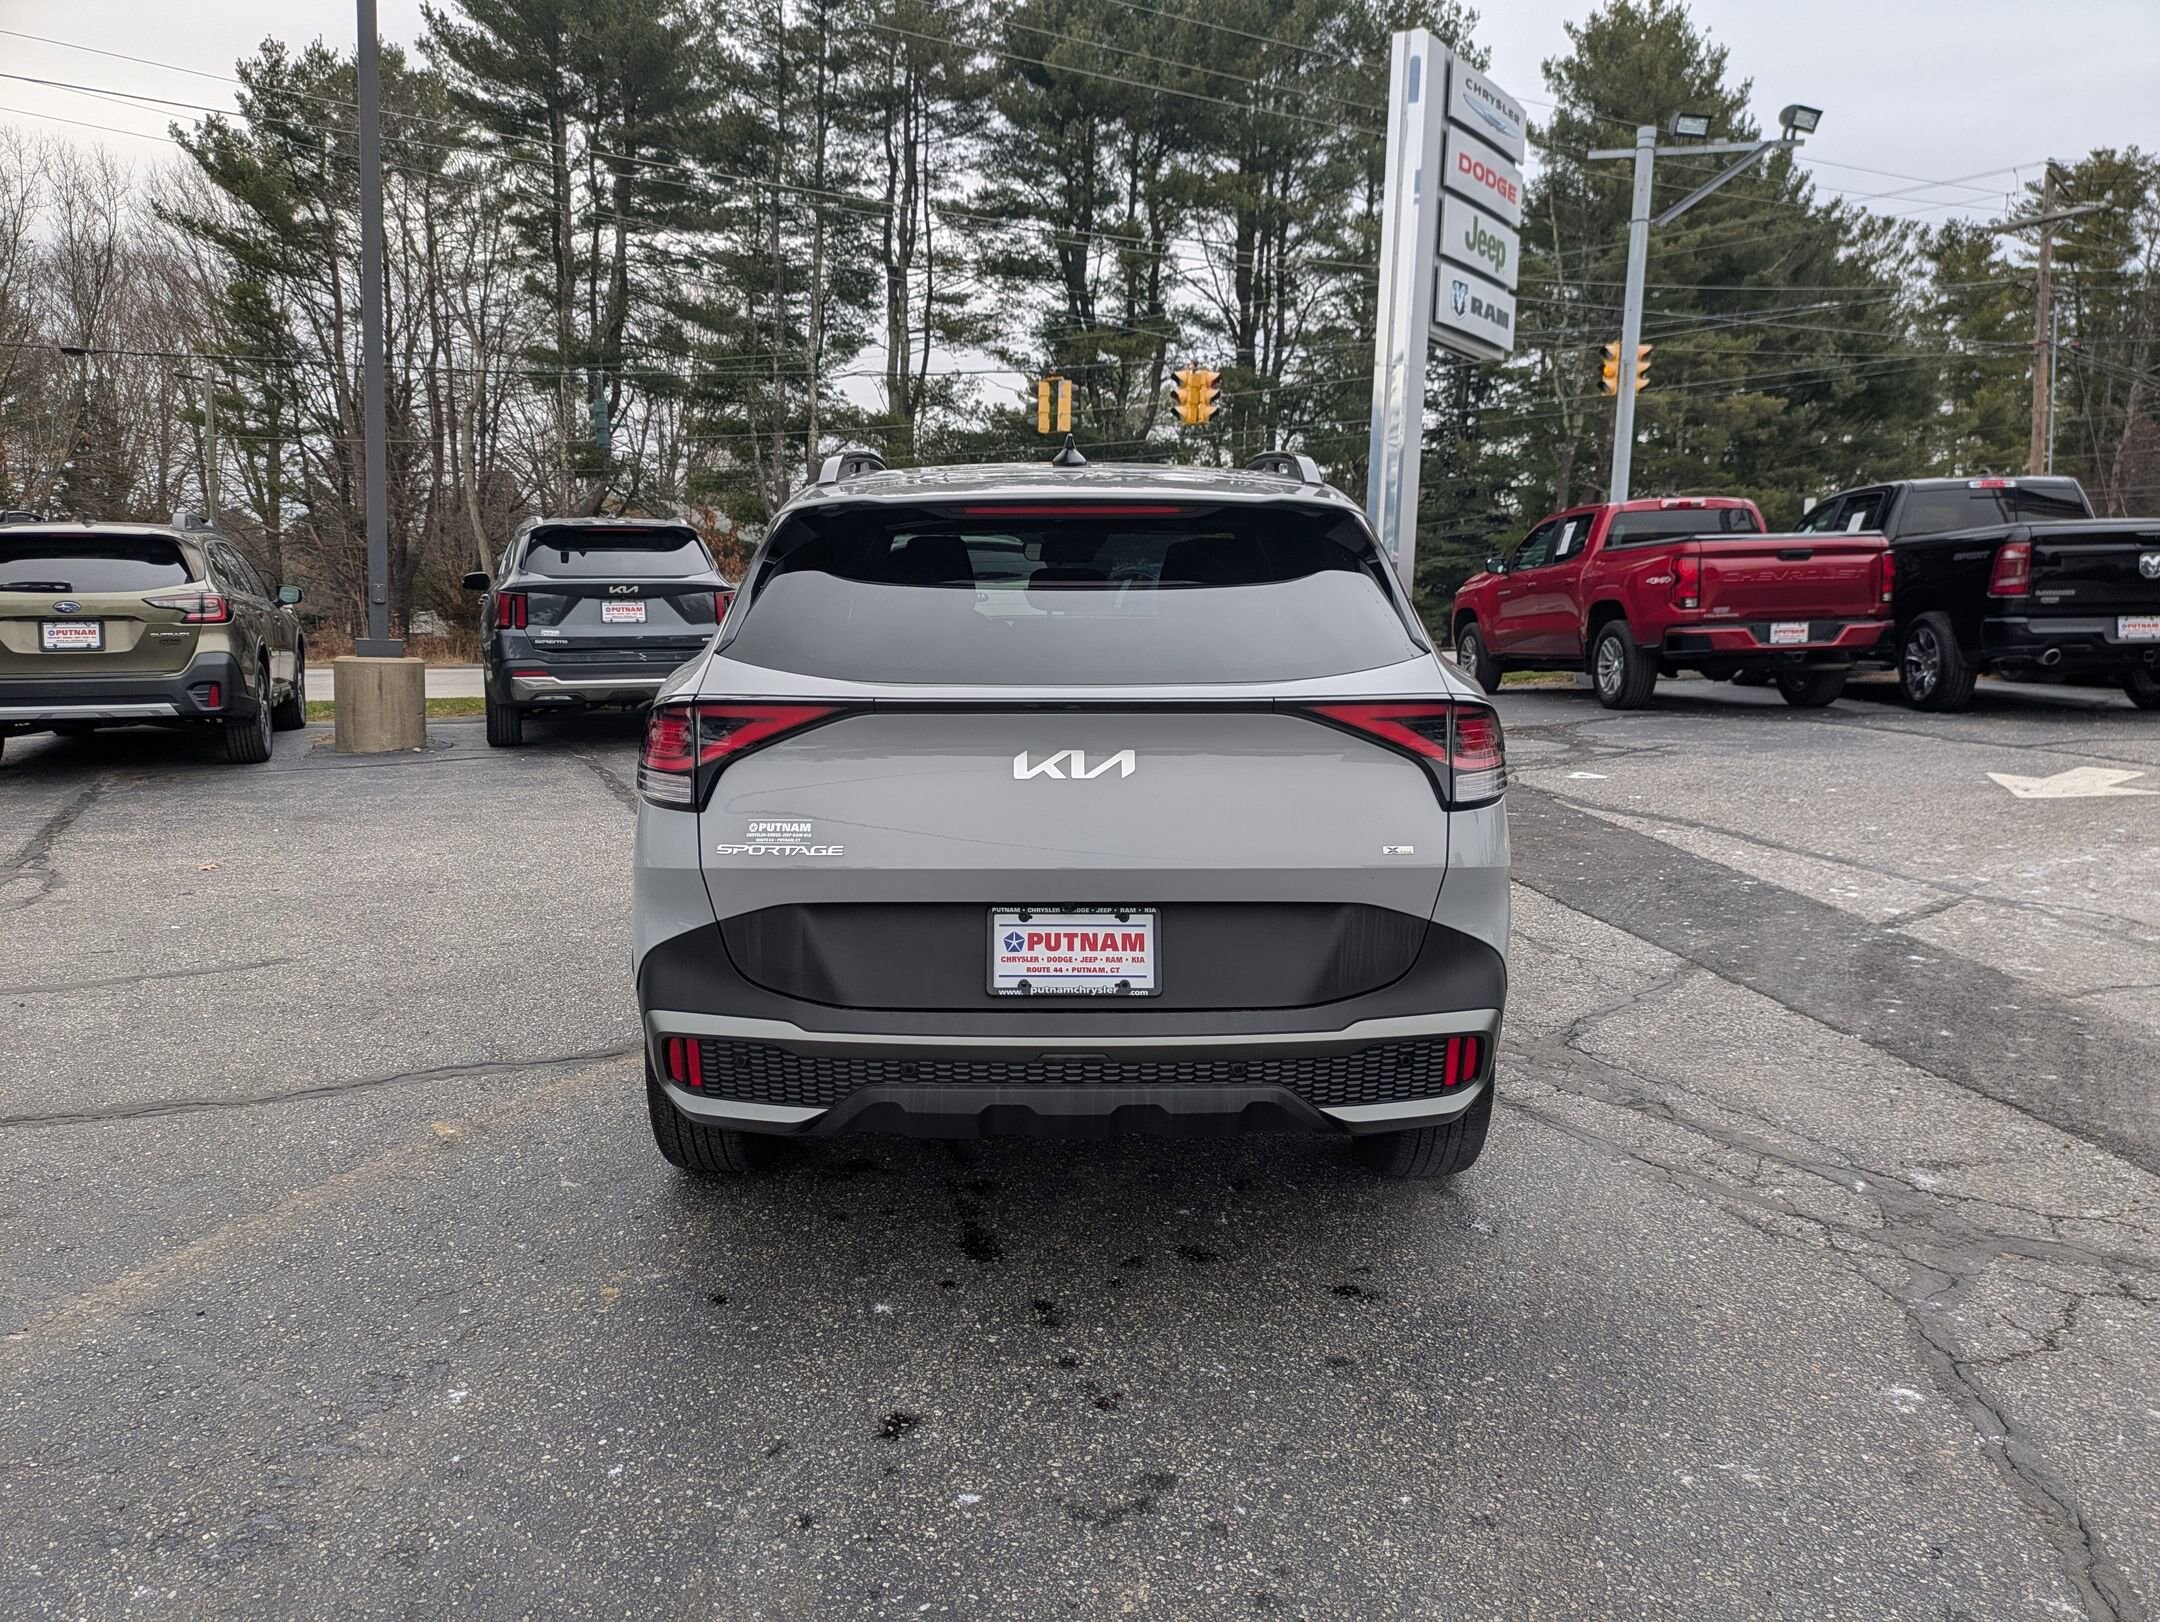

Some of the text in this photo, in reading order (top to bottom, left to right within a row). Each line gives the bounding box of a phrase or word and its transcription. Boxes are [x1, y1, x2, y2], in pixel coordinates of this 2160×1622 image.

[1465, 77, 1521, 126] CHRYSLER
[1458, 152, 1518, 205] DODGE
[1465, 215, 1507, 273] Jeep
[1470, 296, 1510, 331] RAM
[1723, 567, 1868, 583] CHEVROLET
[608, 585, 639, 594] KIA
[1013, 749, 1136, 780] KIA
[758, 822, 812, 832] PUTNAM
[716, 843, 845, 856] SPORTAGE
[1026, 932, 1145, 953] PUTNAM
[1071, 966, 1108, 974] PUTNAM,
